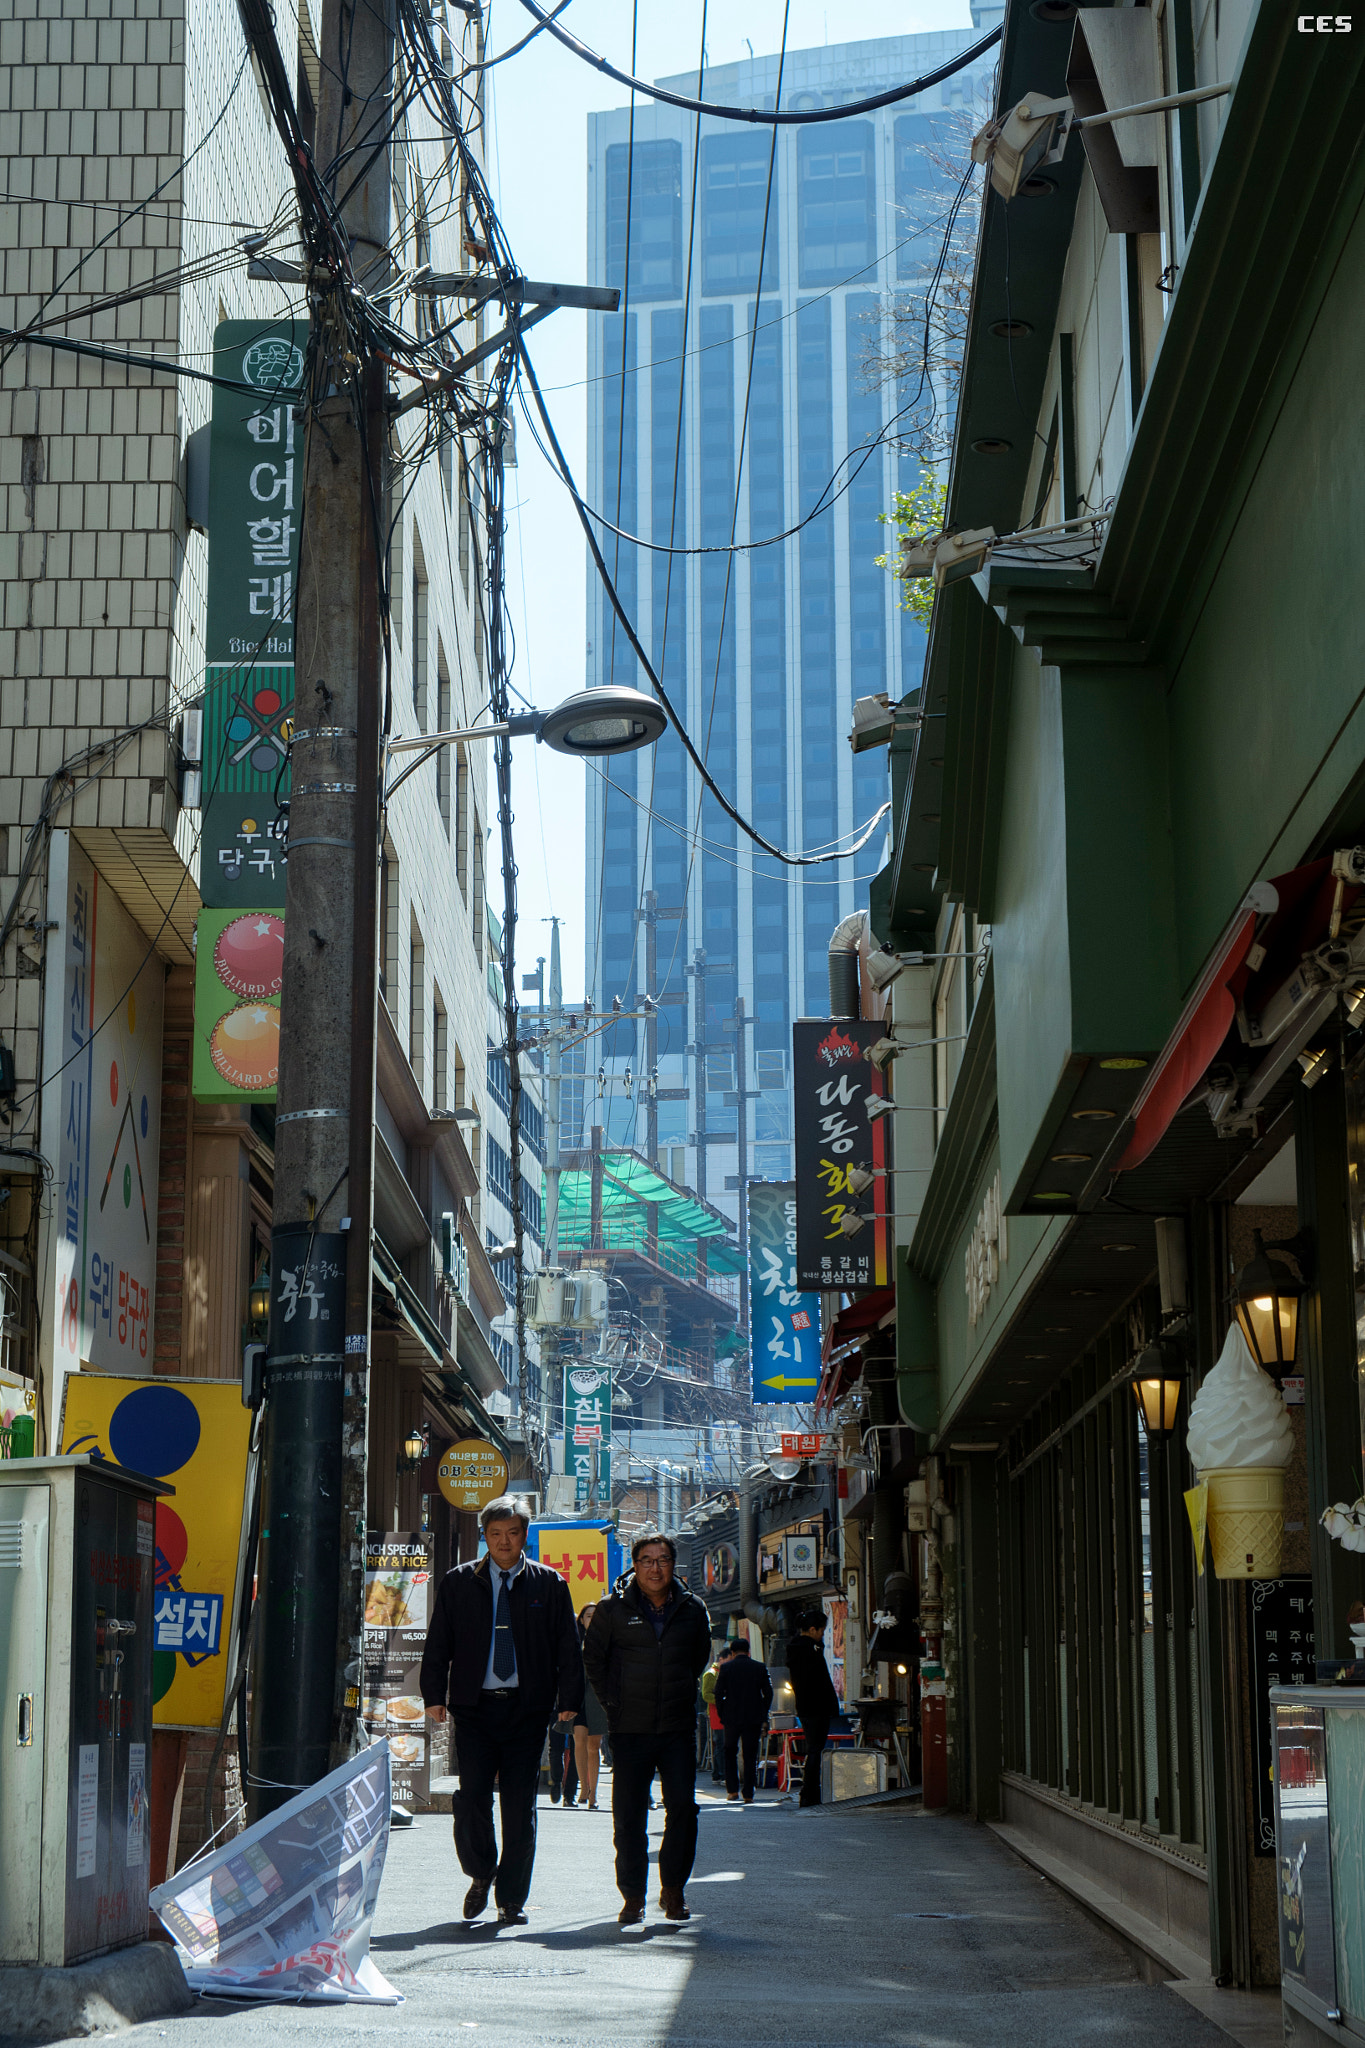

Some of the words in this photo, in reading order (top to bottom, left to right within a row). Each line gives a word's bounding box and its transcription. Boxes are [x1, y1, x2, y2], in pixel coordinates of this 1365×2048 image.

[247, 404, 296, 624] 비어할레
[217, 958, 266, 995] BILLIARD
[213, 1048, 263, 1084] BILLIARD
[277, 1268, 325, 1323] 중구
[821, 1270, 869, 1284] 생삼겹살
[58, 1273, 79, 1354] 18
[90, 1252, 114, 1338] 우리
[118, 1270, 150, 1359] 당구장
[759, 1247, 803, 1363] 참치
[439, 1464, 462, 1478] OB
[450, 1479, 493, 1488] 이사왔습니다
[402, 1556, 427, 1567] RICE
[155, 1598, 218, 1648] 설치
[392, 1789, 414, 1801] alle
